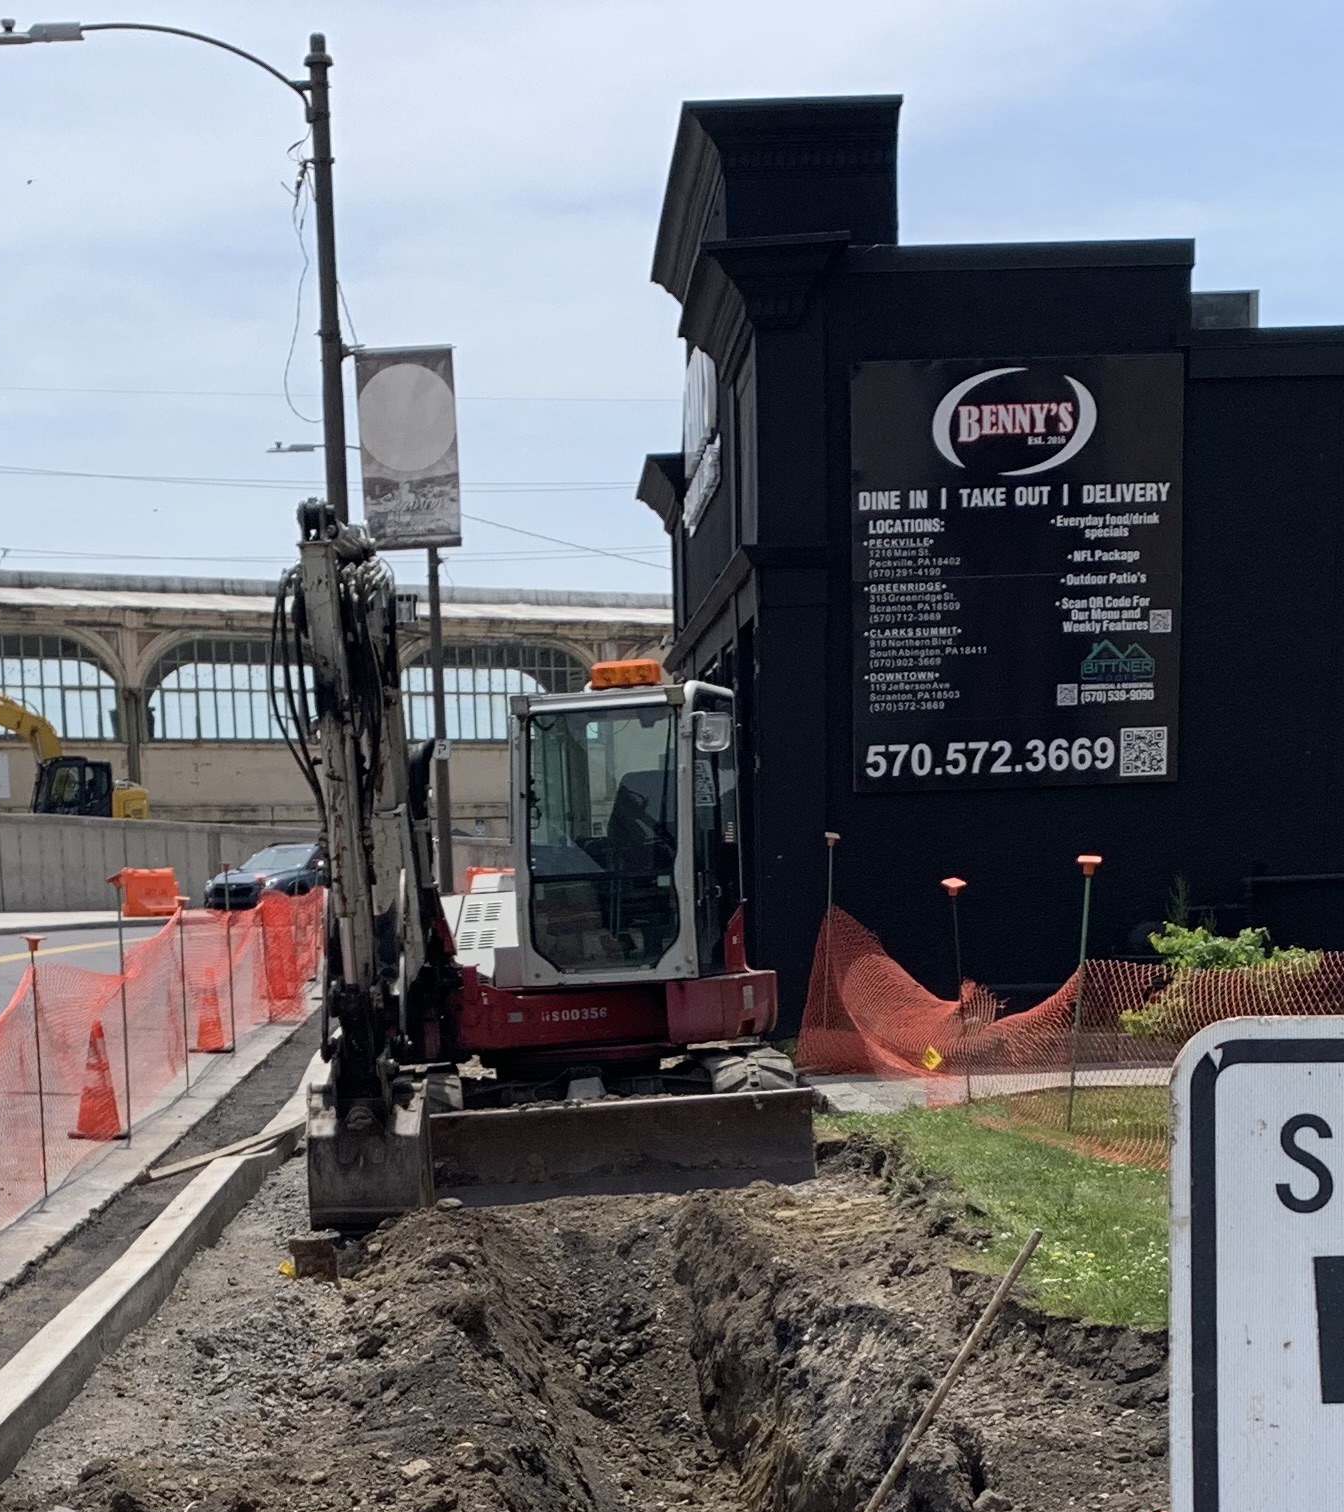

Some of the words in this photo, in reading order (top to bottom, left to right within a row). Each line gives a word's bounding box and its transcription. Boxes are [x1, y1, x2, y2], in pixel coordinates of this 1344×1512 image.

[957, 402, 1075, 442] BENNY'S
[858, 491, 901, 511] DINE
[909, 490, 928, 509] IN
[959, 487, 1006, 508] TAKE
[1014, 485, 1051, 506] OUT
[1082, 482, 1171, 504] DELIVERY
[1106, 512, 1160, 526] food/drink
[868, 518, 945, 535] LOCATIONS:
[1084, 526, 1130, 540] specials
[917, 558, 931, 566] PA
[1094, 549, 1140, 562] Package
[868, 569, 895, 579] (570)
[1109, 571, 1147, 584] Patio's
[917, 603, 931, 611] PA
[1089, 597, 1104, 609] QR
[1105, 596, 1131, 608] Code
[1132, 595, 1151, 607] For
[869, 613, 895, 624] (570)
[1071, 610, 1090, 620] Our
[1091, 609, 1120, 620] Menu
[1121, 607, 1141, 618] and
[1062, 621, 1101, 634] Weekly
[1102, 620, 1149, 631] Features
[945, 647, 959, 655] PA
[869, 659, 895, 669] (570)
[1083, 661, 1152, 673] BITTNER
[917, 692, 931, 700] PA
[1080, 690, 1107, 704] (570)
[1107, 689, 1154, 701] 539-9090
[869, 703, 897, 714] (570)
[897, 701, 945, 711] 572-3669
[865, 737, 1115, 778] 570.572.3669
